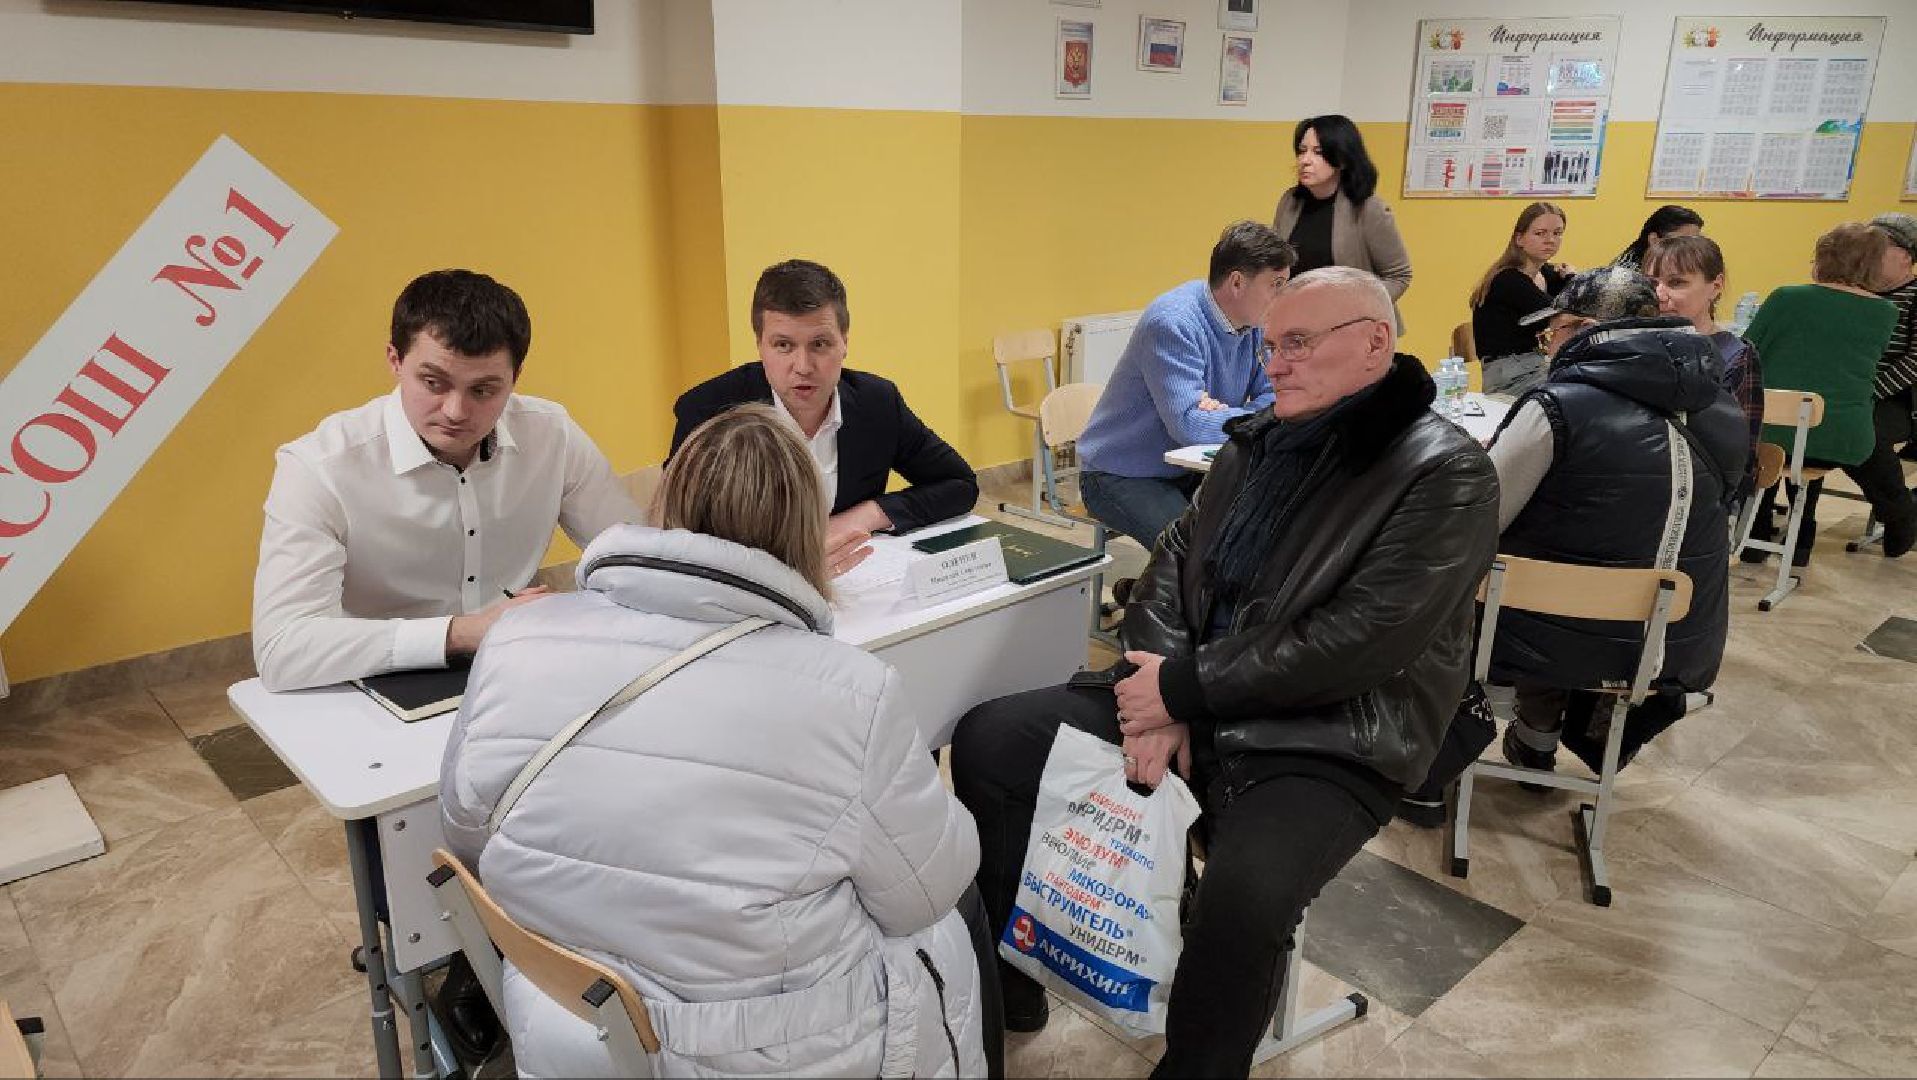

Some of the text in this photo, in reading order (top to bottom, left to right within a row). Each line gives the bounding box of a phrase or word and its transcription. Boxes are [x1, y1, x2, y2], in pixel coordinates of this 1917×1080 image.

[1489, 24, 1602, 52] Информация
[1746, 22, 1864, 51] Информация
[0, 184, 296, 573] СОШ №1
